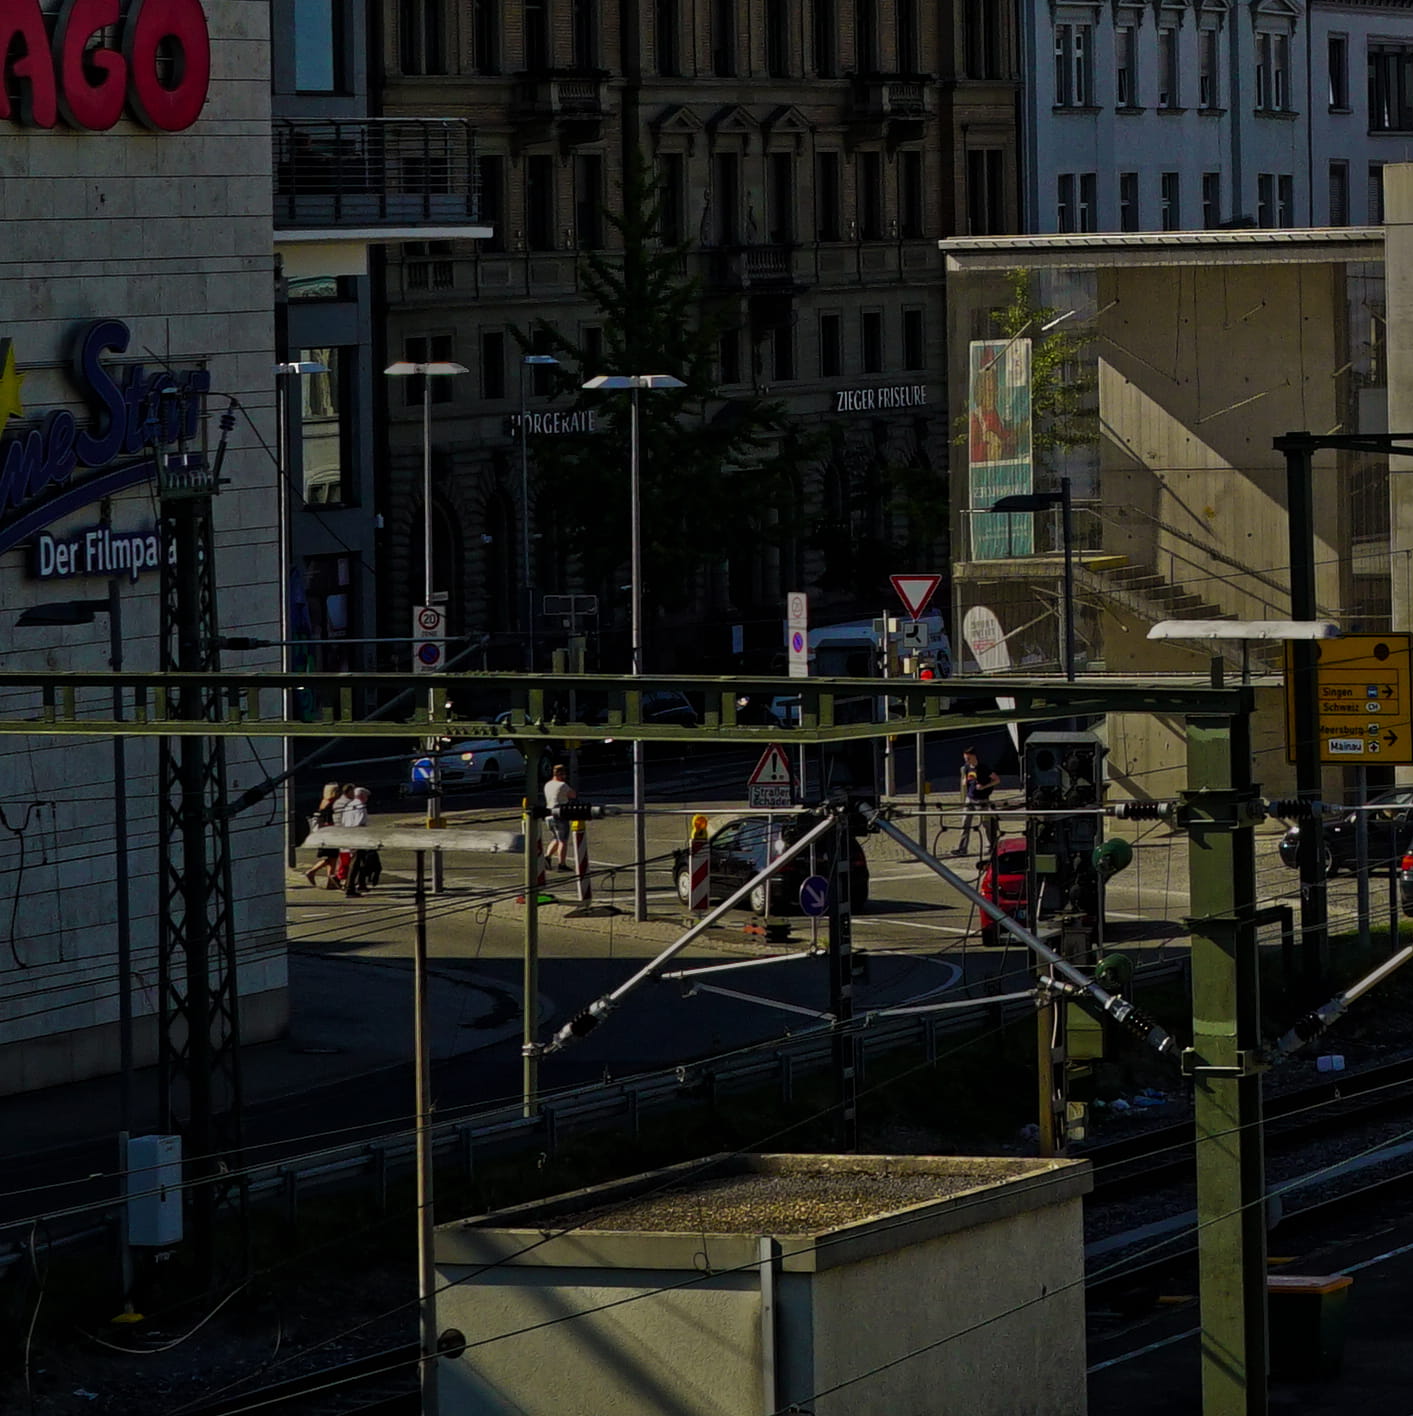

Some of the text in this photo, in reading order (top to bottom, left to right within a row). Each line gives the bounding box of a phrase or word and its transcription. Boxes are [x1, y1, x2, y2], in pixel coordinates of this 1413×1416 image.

[835, 384, 927, 413] ZIEGER FRISEURE
[38, 535, 79, 577] Der
[423, 613, 436, 625] 20
[1322, 687, 1353, 699] Singen
[1323, 703, 1360, 712] Schweiz
[1330, 741, 1362, 751] Mainau
